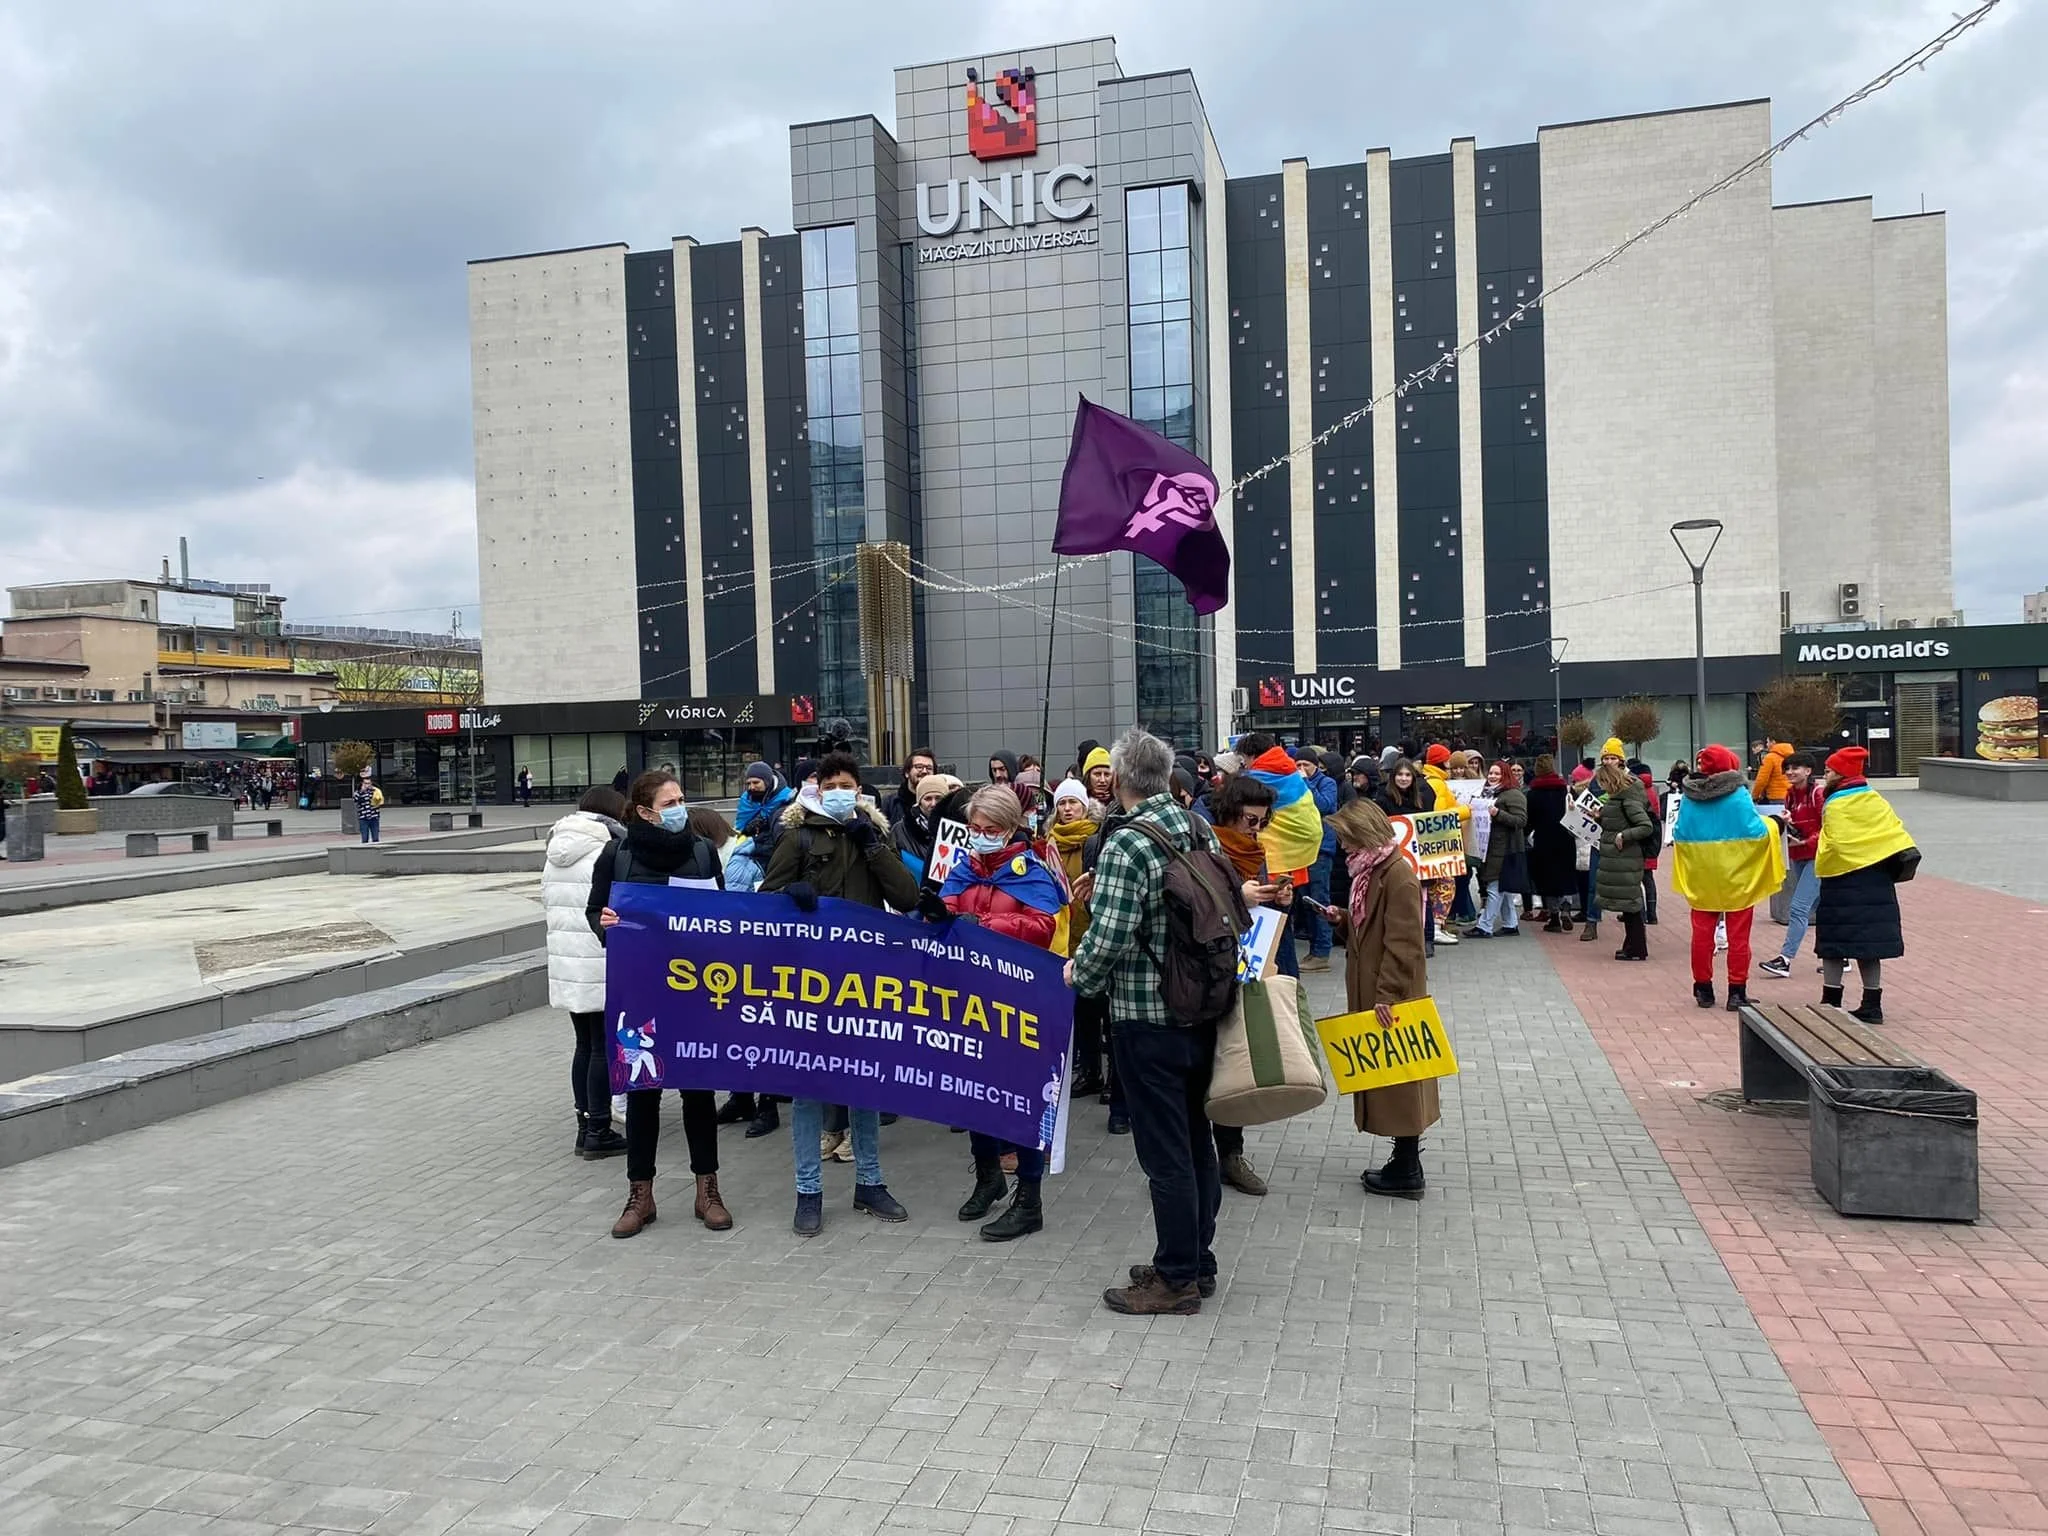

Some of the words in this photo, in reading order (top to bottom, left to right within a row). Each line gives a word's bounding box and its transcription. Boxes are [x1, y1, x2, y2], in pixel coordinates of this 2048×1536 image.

[916, 163, 1094, 238] UNIC
[919, 241, 998, 264] MAGAZIN
[1002, 228, 1099, 254] UNIVERSAL
[1798, 639, 1950, 662] McDonald's
[1290, 676, 1356, 698] UNIC
[1291, 698, 1320, 706] MAGAZIN
[1321, 697, 1356, 705] UNIVERSAL
[427, 714, 453, 730] ROGOB
[1415, 812, 1462, 835] DESPRE
[668, 915, 733, 933] MARS
[739, 920, 823, 940] PENTRU
[829, 926, 886, 946] PACE
[969, 950, 993, 970] ЗА
[997, 958, 1035, 983] МИР
[666, 958, 1041, 1050] SOLIDARITATE
[740, 1001, 776, 1026] SĂ
[785, 1009, 818, 1032] NE
[827, 1015, 903, 1042] UNIM
[675, 1041, 718, 1059] МЫ
[726, 1043, 886, 1083] СОЛИДАРНЫ,
[894, 1064, 934, 1088] МЫ
[940, 1073, 1032, 1115] ВМЕСТЕ!
